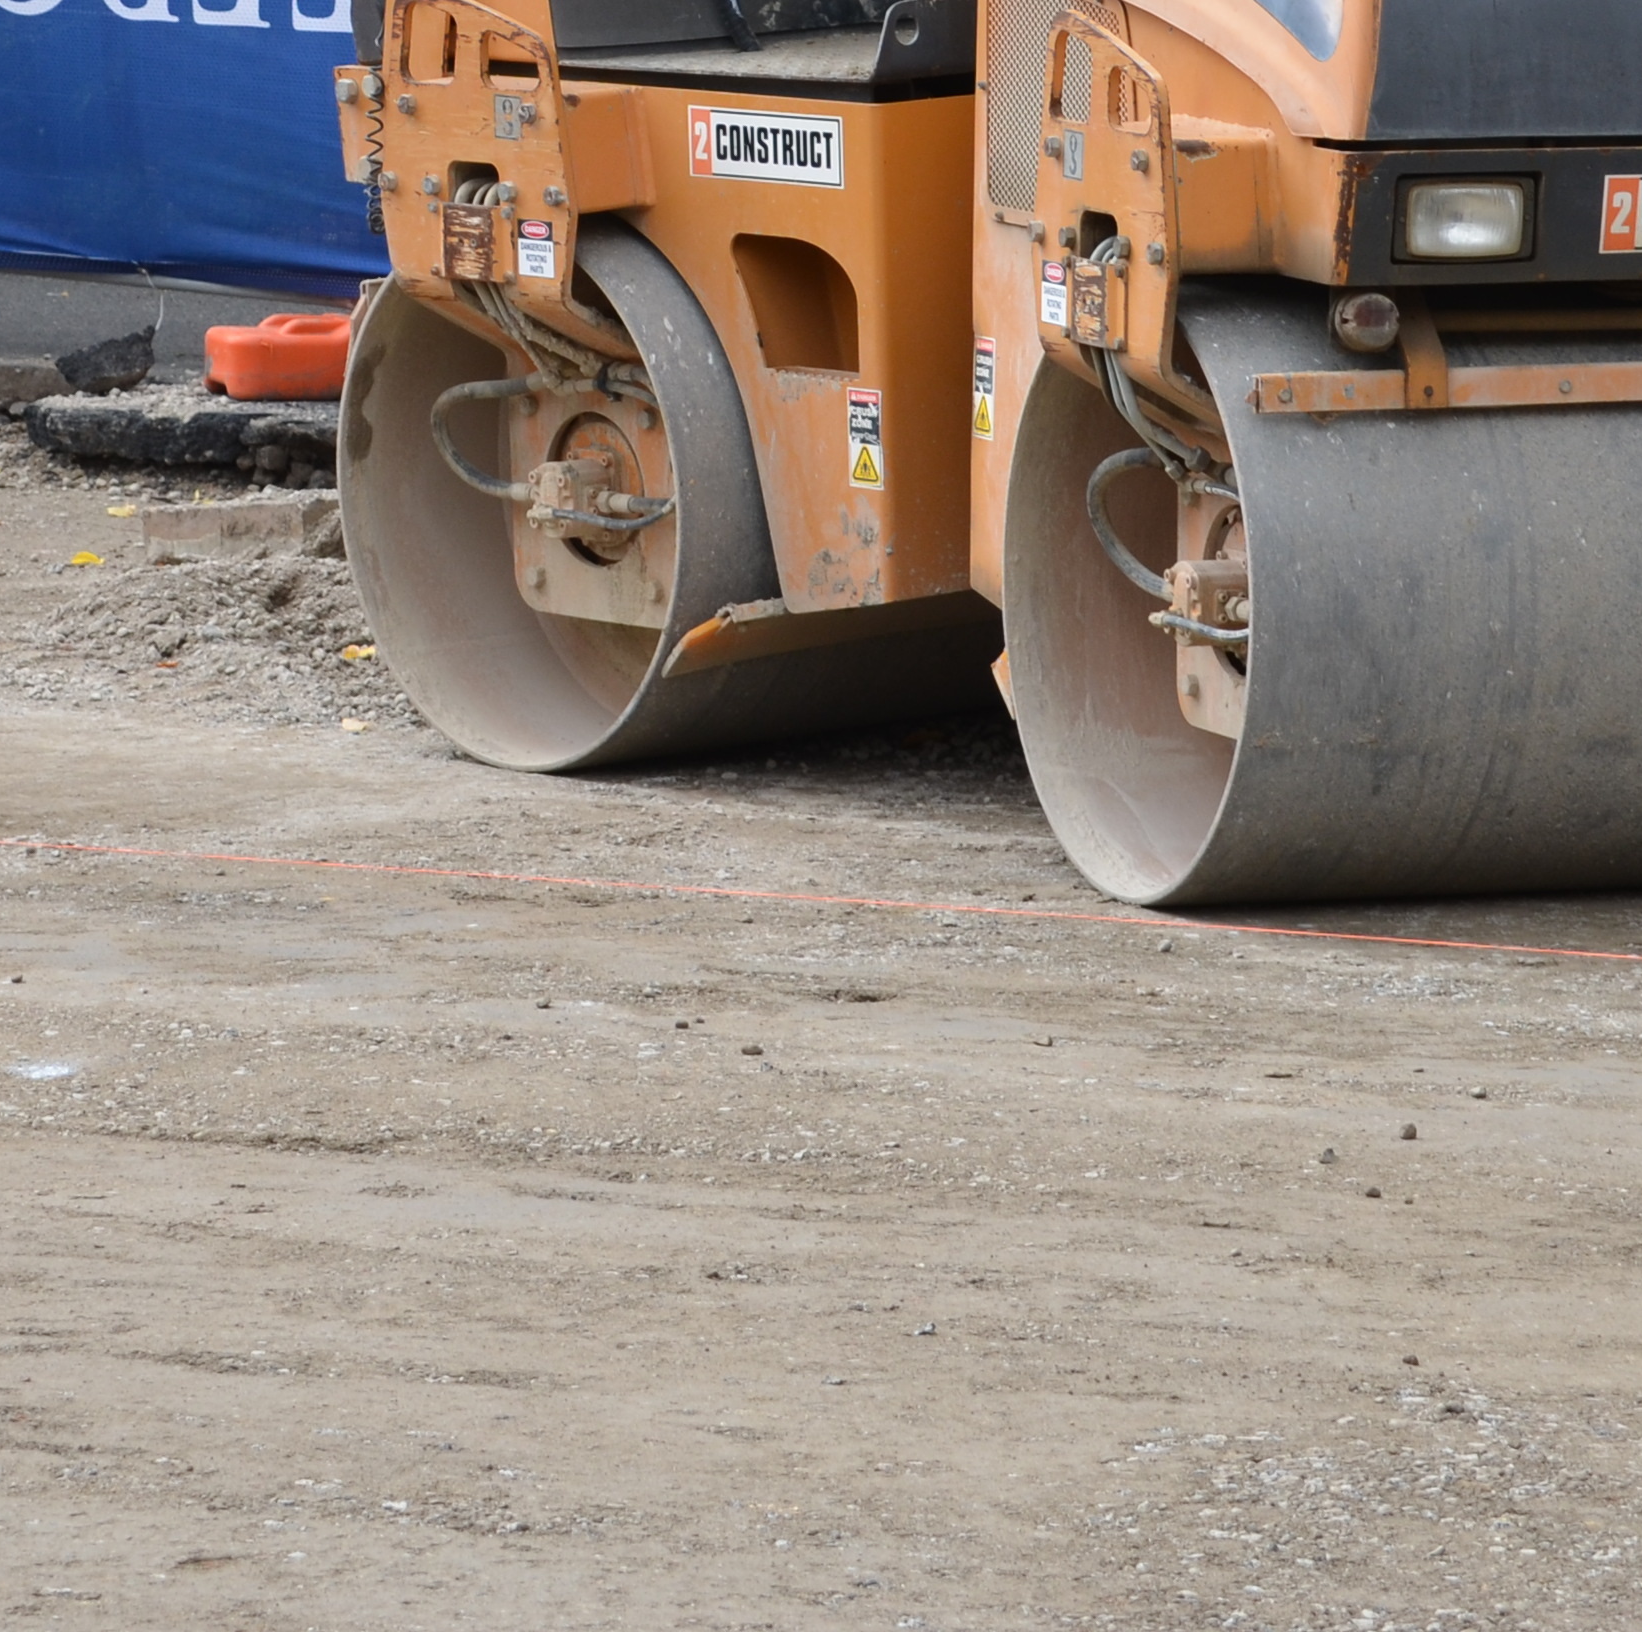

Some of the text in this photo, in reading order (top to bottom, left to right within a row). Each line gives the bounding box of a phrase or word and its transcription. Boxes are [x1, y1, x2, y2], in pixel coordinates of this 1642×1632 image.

[694, 121, 833, 169] 2 CONSTRUCT
[1610, 191, 1633, 234] 2
